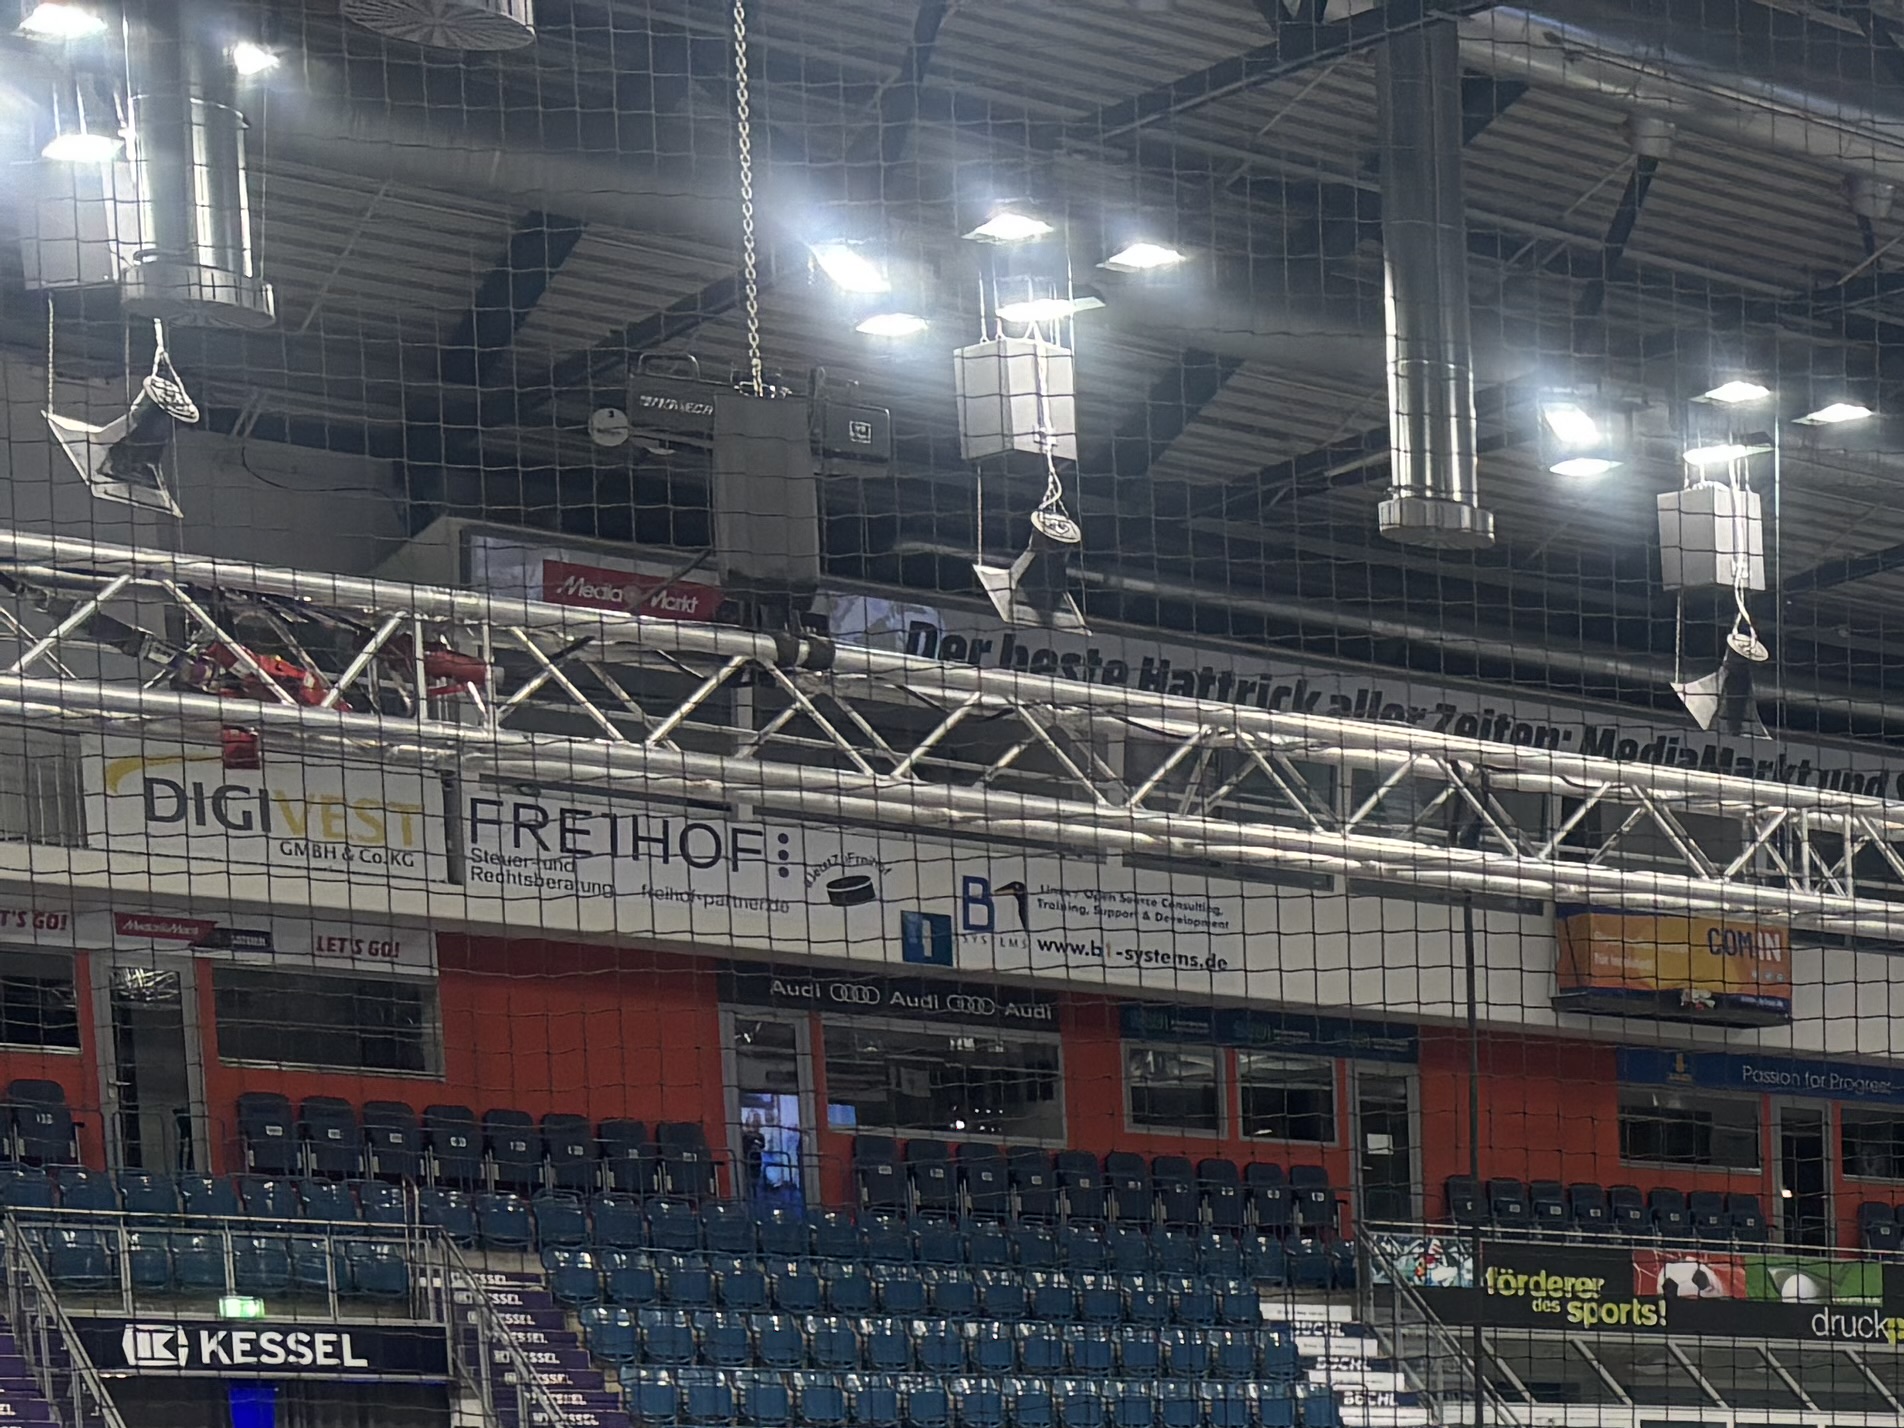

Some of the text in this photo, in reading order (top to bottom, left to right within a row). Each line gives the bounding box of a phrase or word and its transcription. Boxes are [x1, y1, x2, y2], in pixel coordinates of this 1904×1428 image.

[144, 777, 425, 848] DIGIVEST
[468, 795, 765, 874] FREIHOF
[770, 980, 1052, 1020] Audi Audi Audi
[1742, 1065, 1800, 1086] Passion
[1804, 1071, 1826, 1088] for
[1485, 1267, 1603, 1298] förderer
[1533, 1296, 1666, 1329] des sports!
[200, 1332, 368, 1368] KESSEL
